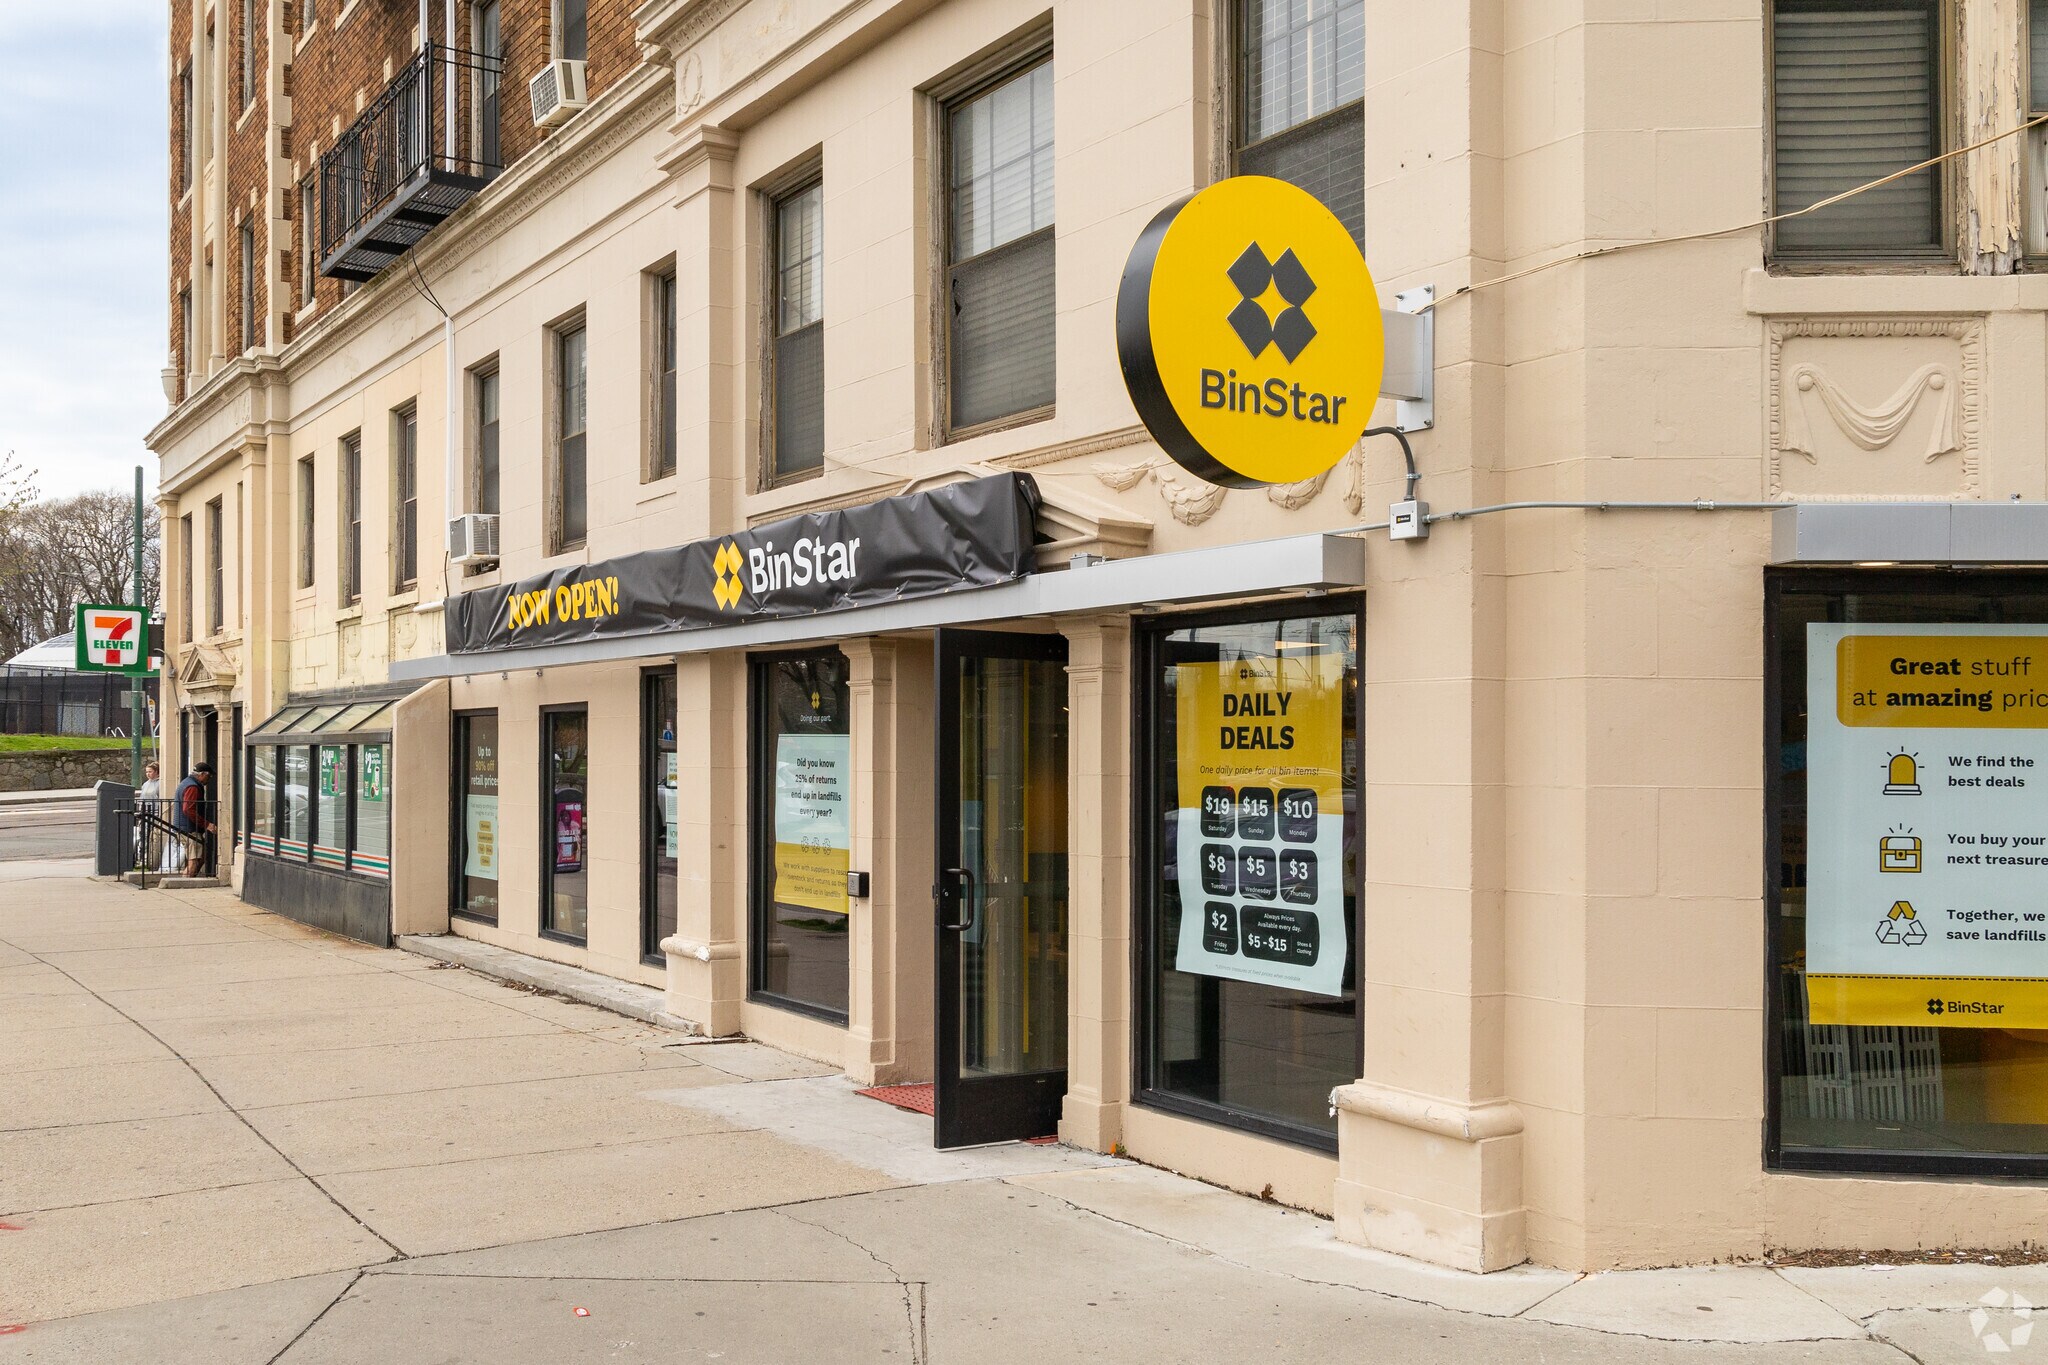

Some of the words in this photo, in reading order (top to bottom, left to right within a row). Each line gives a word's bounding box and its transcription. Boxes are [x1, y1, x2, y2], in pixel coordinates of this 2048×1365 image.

[1200, 368, 1347, 424] BinStar
[749, 535, 860, 594] BinStar
[508, 588, 551, 629] NOW
[556, 576, 619, 623] OPEN!
[95, 616, 132, 664] 7
[1890, 657, 1961, 675] Great
[1971, 656, 2031, 676] stuff
[1223, 692, 1292, 717] DAILY
[1853, 690, 1877, 706] at
[1886, 688, 1993, 712] amazing
[1220, 725, 1294, 750] DEALS
[477, 746, 485, 759] Up
[485, 746, 491, 757] to
[487, 760, 495, 771] off
[797, 758, 806, 767] Did
[807, 760, 818, 769] you
[819, 759, 835, 768] know
[1948, 756, 1972, 767] We
[1976, 755, 2005, 767] find
[2010, 756, 2034, 767] the
[1200, 765, 1214, 774] One
[1216, 765, 1233, 776] daily
[1235, 765, 1253, 777] price
[1255, 765, 1265, 775] for
[1267, 765, 1277, 775] all
[1279, 766, 1291, 776] bin
[1293, 766, 1320, 776] items!
[471, 774, 484, 786] retail
[795, 774, 807, 783] 25%
[809, 774, 815, 784] of
[816, 775, 837, 785] returns
[1948, 776, 1981, 787] best
[1985, 776, 2025, 787] deals
[791, 790, 801, 799] end
[803, 791, 810, 801] up
[811, 791, 817, 800] in
[818, 791, 842, 802] landfills
[1205, 794, 1230, 815] $19
[1243, 796, 1268, 817] $15
[1283, 797, 1312, 819] $10
[800, 808, 815, 818] every
[816, 808, 832, 819] year?
[1208, 825, 1227, 833] Saturday
[1289, 829, 1308, 837] Monday
[1947, 834, 1976, 845] You
[1980, 834, 2008, 848] buy
[2012, 836, 2046, 848] your
[1208, 853, 1226, 873] $8
[1246, 855, 1265, 877] $5
[1947, 854, 1981, 865] next
[1986, 854, 2048, 866] treasure
[1289, 859, 1308, 880] $3
[1290, 890, 1311, 899] Thursday
[1211, 910, 1228, 931] $2
[1264, 913, 1280, 921] Always
[1947, 909, 2018, 923] Together,
[2023, 913, 2046, 922] we
[1279, 924, 1291, 932] every
[1292, 925, 1302, 933] day.
[1248, 933, 1260, 948] $5
[1268, 936, 1287, 952] $15
[1946, 931, 1980, 940] save
[1984, 930, 2046, 942] landfills
[1214, 941, 1227, 949] Friday
[1297, 948, 1312, 956] Clothing
[1948, 1001, 2005, 1014] BinStar
